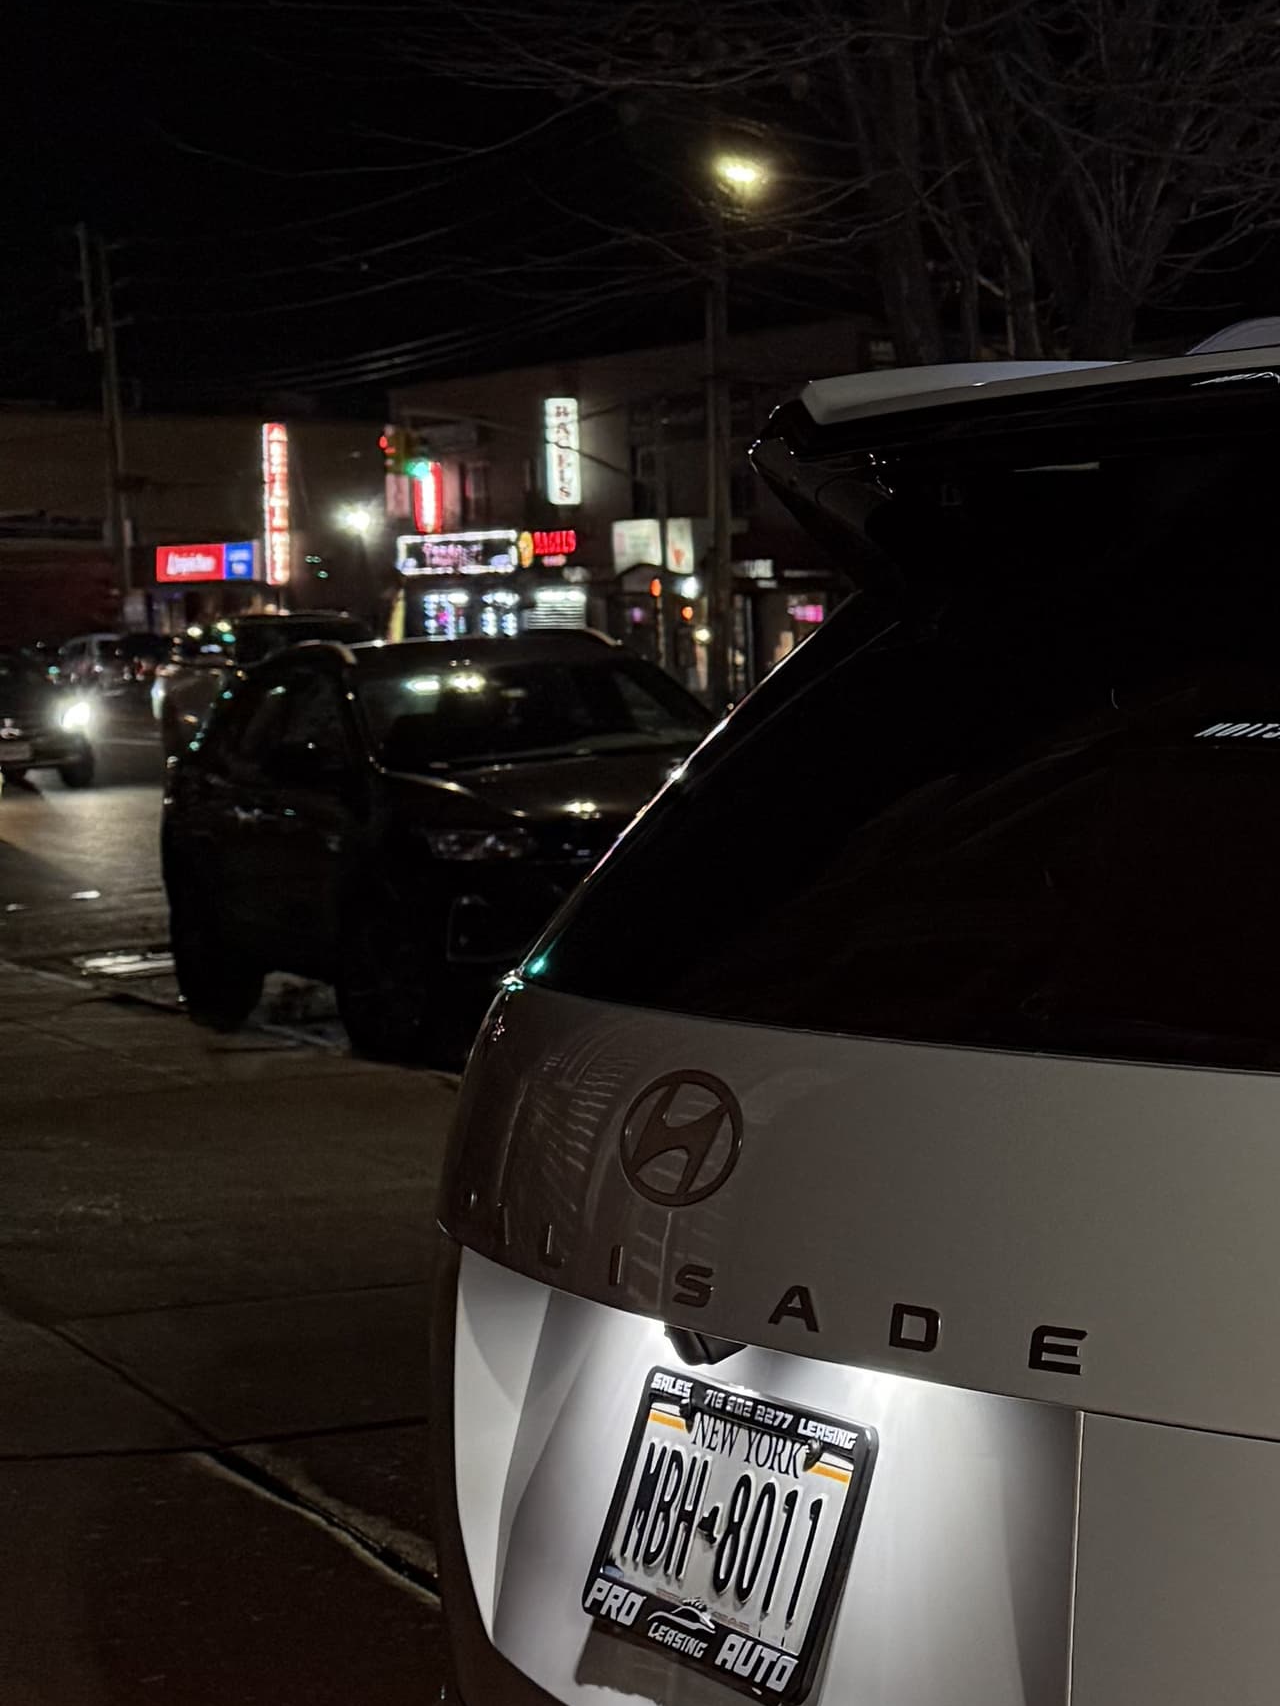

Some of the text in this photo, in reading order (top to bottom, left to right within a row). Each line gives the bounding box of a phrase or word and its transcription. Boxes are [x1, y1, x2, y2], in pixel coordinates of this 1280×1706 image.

[650, 1372, 693, 1398] SALES
[754, 1404, 794, 1429] 2277
[796, 1417, 858, 1450] LEASING
[690, 1413, 807, 1481] NEW YORK
[583, 1577, 647, 1627] PRO
[713, 1633, 799, 1693] AUTO
[647, 1622, 710, 1659] LEASING
